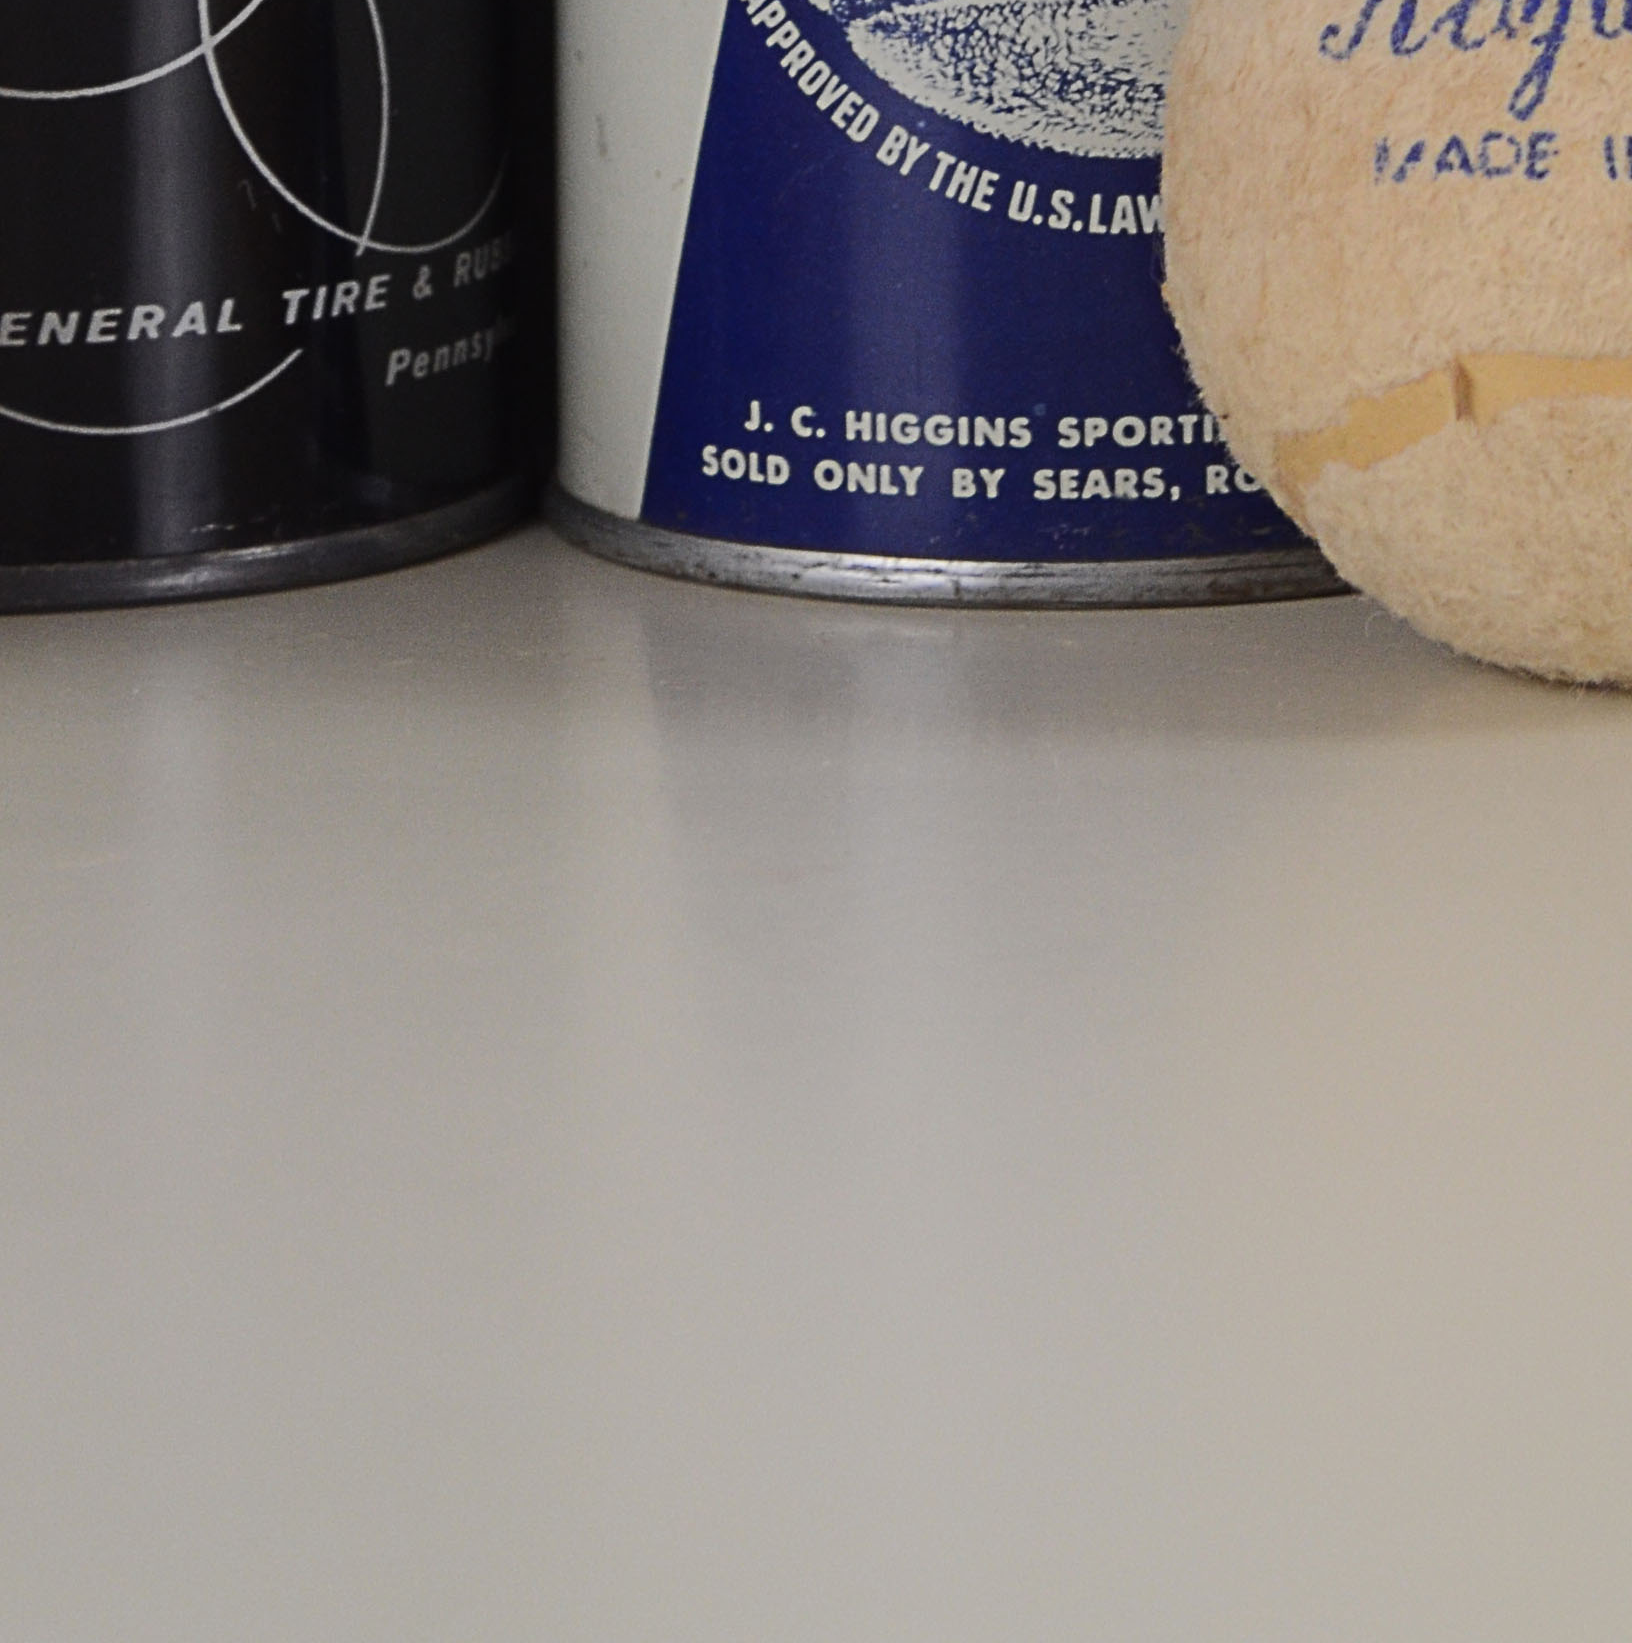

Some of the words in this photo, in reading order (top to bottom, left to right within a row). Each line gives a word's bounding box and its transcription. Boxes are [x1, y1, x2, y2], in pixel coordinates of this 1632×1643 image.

[875, 124, 929, 177] BY
[928, 149, 1000, 213] THE
[1374, 131, 1559, 183] MADE
[282, 273, 392, 326] TIRE
[413, 265, 434, 300] &
[745, 401, 774, 432] J.
[790, 406, 826, 438] C.
[845, 410, 1032, 448] HIGGINS
[702, 444, 790, 486] SOLD
[813, 458, 924, 496] ONLY
[952, 467, 1005, 499] BY
[1033, 467, 1181, 502] SEARS,
